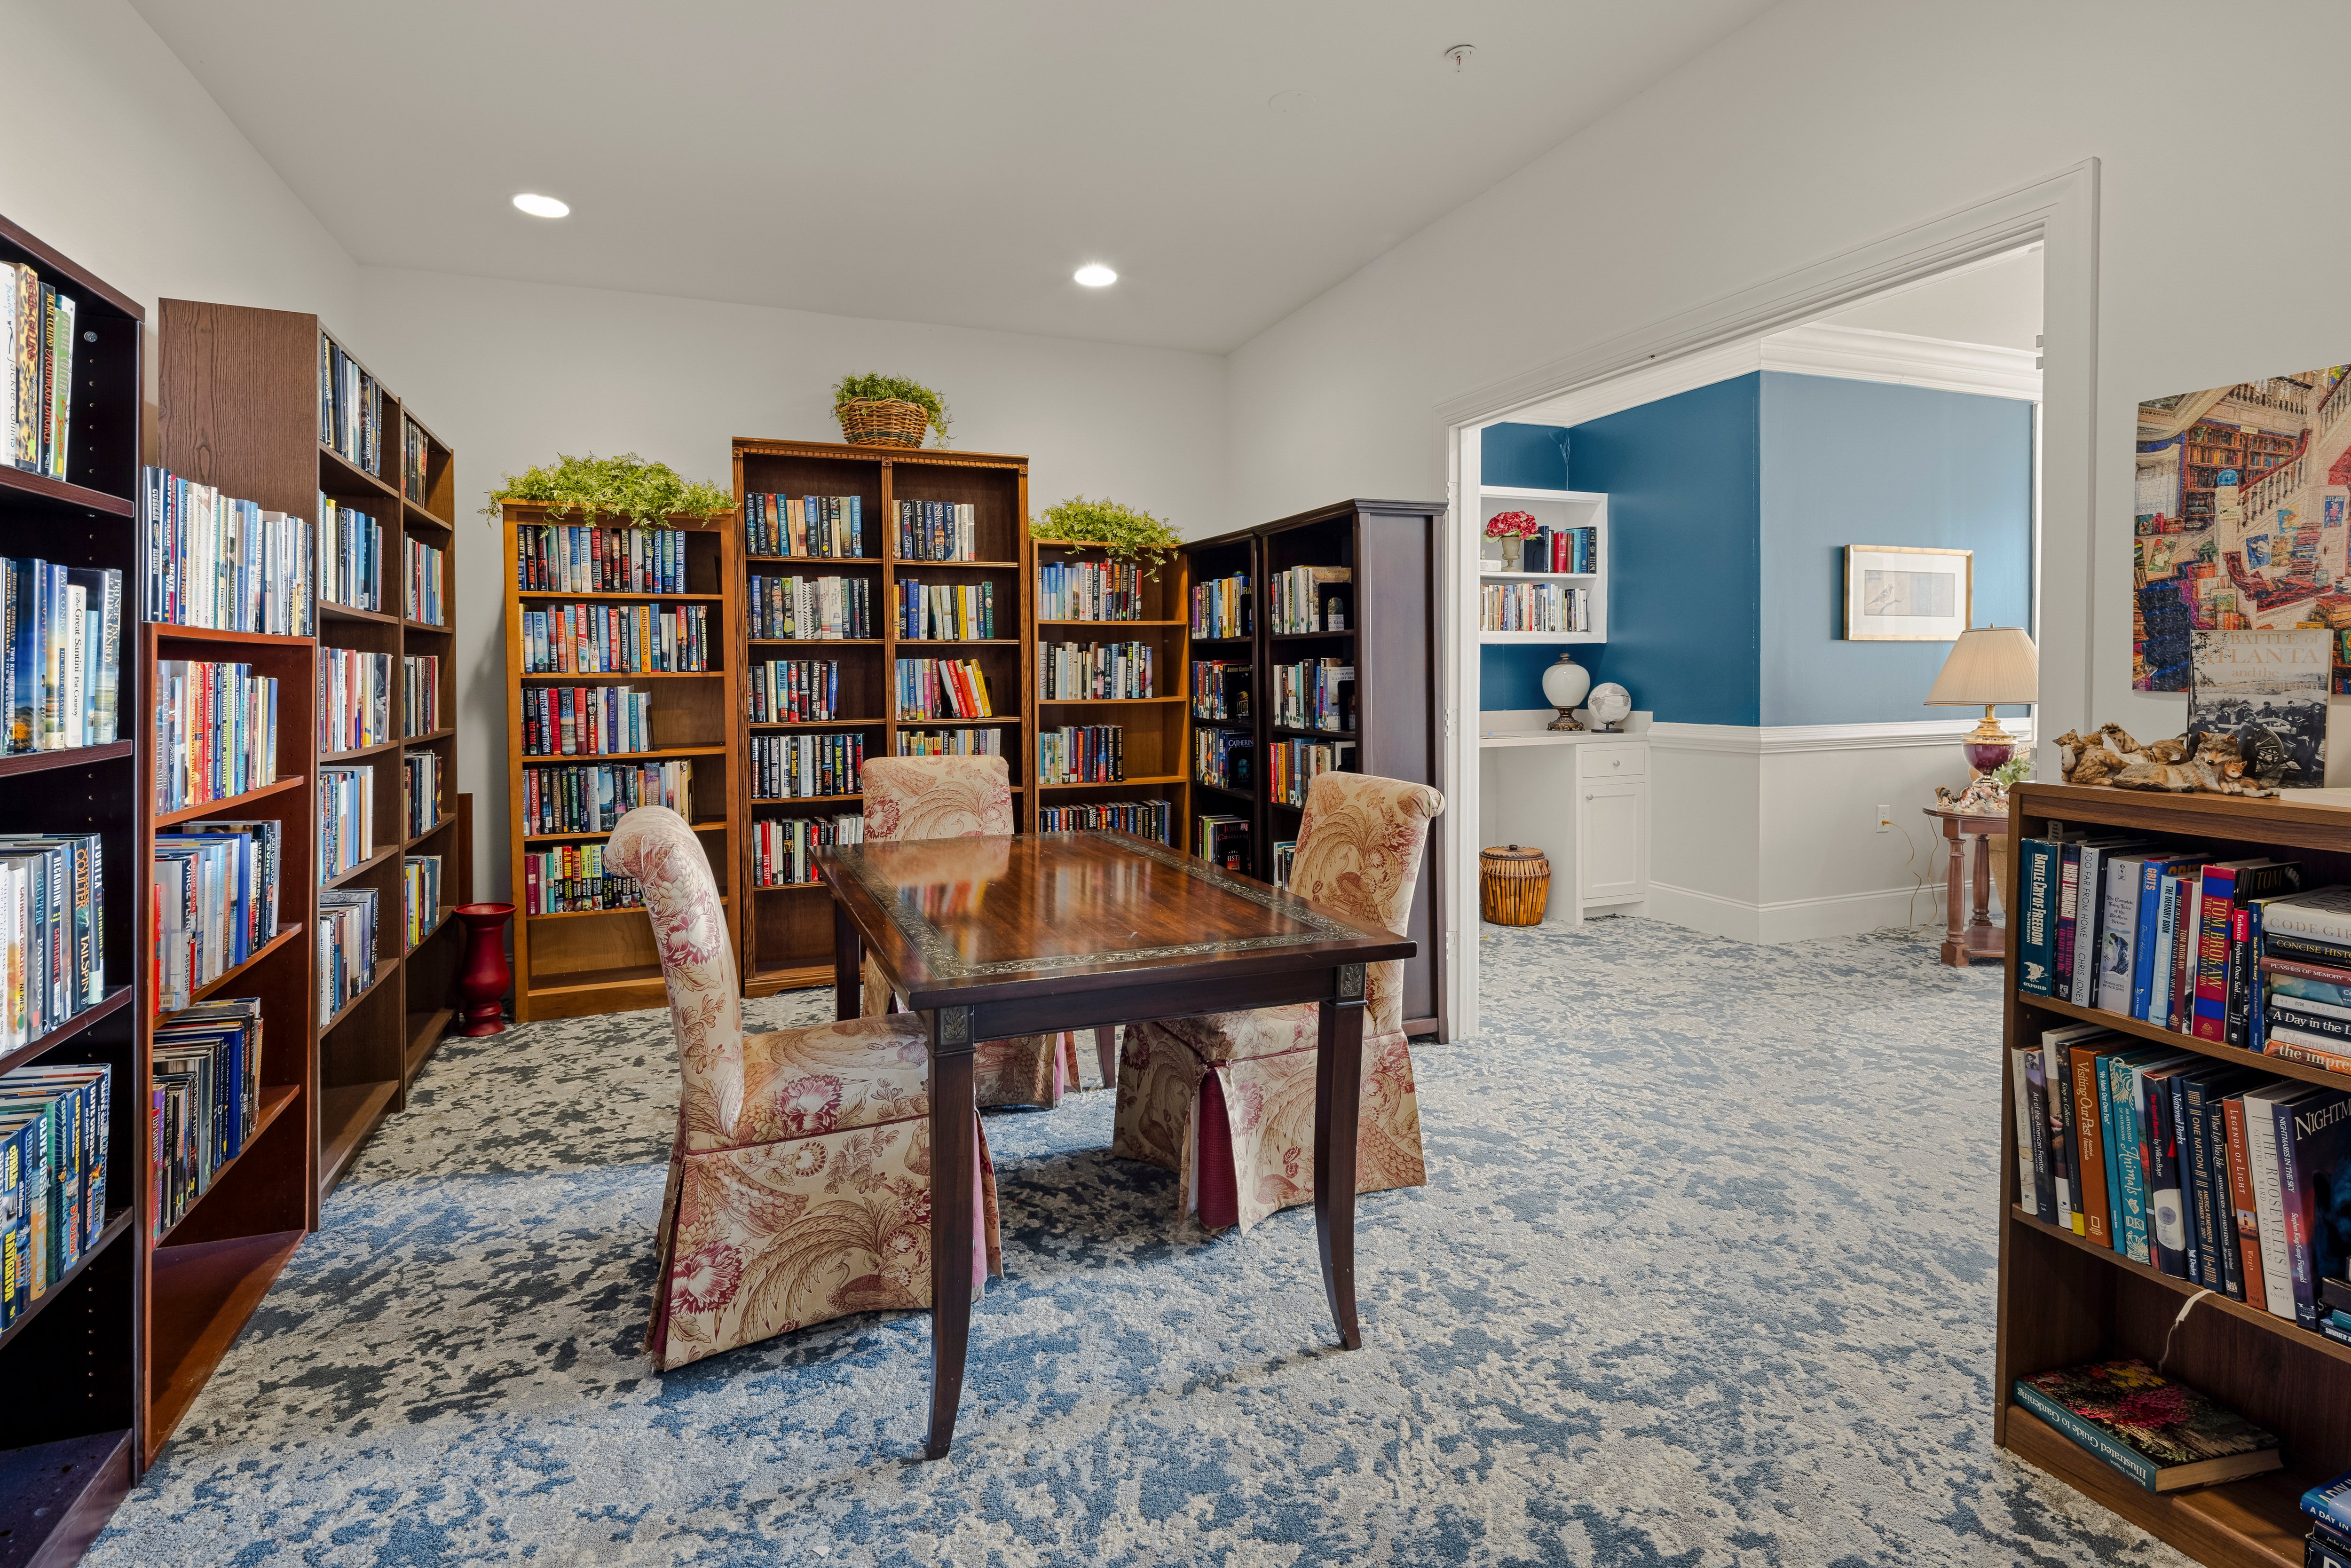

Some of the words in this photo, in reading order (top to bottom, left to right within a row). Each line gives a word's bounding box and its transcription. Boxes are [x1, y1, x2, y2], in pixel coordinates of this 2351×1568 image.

[47, 292, 55, 315] JACKIE
[46, 317, 54, 348] COLLINS
[74, 608, 83, 636] Great
[2230, 633, 2298, 644] BATTLE
[2305, 633, 2321, 644] of
[2203, 648, 2322, 663] ATLANTA
[2232, 668, 2258, 677] and
[2258, 667, 2280, 677] the
[60, 686, 65, 695] OF
[2034, 853, 2048, 882] BATTLE
[2062, 863, 2078, 883] RUSH
[2146, 868, 2157, 890] GRITS
[53, 856, 61, 907] RECKONING
[76, 848, 86, 911] COULTER
[2033, 882, 2047, 898] CRY
[2033, 898, 2044, 908] OF
[2061, 883, 2077, 919] LIMBAUGH
[2163, 896, 2172, 918] MEMORY
[2211, 900, 2227, 928] TOM
[2031, 908, 2046, 946] FREEDOM
[2080, 914, 2088, 938] HOME
[2202, 911, 2211, 946] GREATEST
[2270, 918, 2318, 934] CODE
[2277, 940, 2321, 953] CONCISE
[80, 931, 90, 993] TAILSPIN
[2077, 953, 2086, 975] CHRIS
[2170, 940, 2179, 977] GENERATION
[2208, 932, 2225, 989] BROKAW
[2271, 963, 2301, 972] FLASHES
[2313, 971, 2343, 980] MEMORY
[2023, 982, 2046, 991] OXFORD
[2273, 1011, 2282, 1021] A
[2285, 1013, 2307, 1026] Day
[2309, 1018, 2319, 1028] in
[2323, 1021, 2341, 1032] the
[2076, 1062, 2090, 1096] Visiting
[2080, 1097, 2093, 1118] Our
[2172, 1092, 2184, 1125] National
[2081, 1117, 2094, 1136] Past
[2175, 1126, 2185, 1145] Parks
[2229, 1110, 2240, 1148] LEGENDS
[2279, 1116, 2290, 1158] NIGHTMARES
[2194, 1137, 2204, 1169] NATION
[2262, 1132, 2277, 1159] THE
[2119, 1143, 2141, 1195] Animals
[2235, 1152, 2242, 1163] OF
[2236, 1166, 2246, 1194] LIGHT
[2126, 1216, 2144, 1231] DK
[2266, 1168, 2287, 1266] ROOSEVELTS
[2291, 1213, 2300, 1231] Stephen
[70, 1203, 79, 1256] STORM
[2293, 1232, 2305, 1259] King/f-stop
[5, 1229, 17, 1303] NAVIGATOR
[2247, 1250, 2255, 1271] Wargin
[2297, 1259, 2307, 1283] Fitzgerald
[2270, 1292, 2289, 1301] KNOPF
[2325, 1328, 2347, 1340] SOMMER
[2017, 1387, 2060, 1422] Gardening
[2061, 1418, 2070, 1429] to
[2072, 1425, 2099, 1448] Guide
[2100, 1442, 2147, 1480] Illustrated
[2319, 1510, 2335, 1524] DAY
[2339, 1522, 2349, 1531] IN
[2327, 1536, 2339, 1546] Jacka
